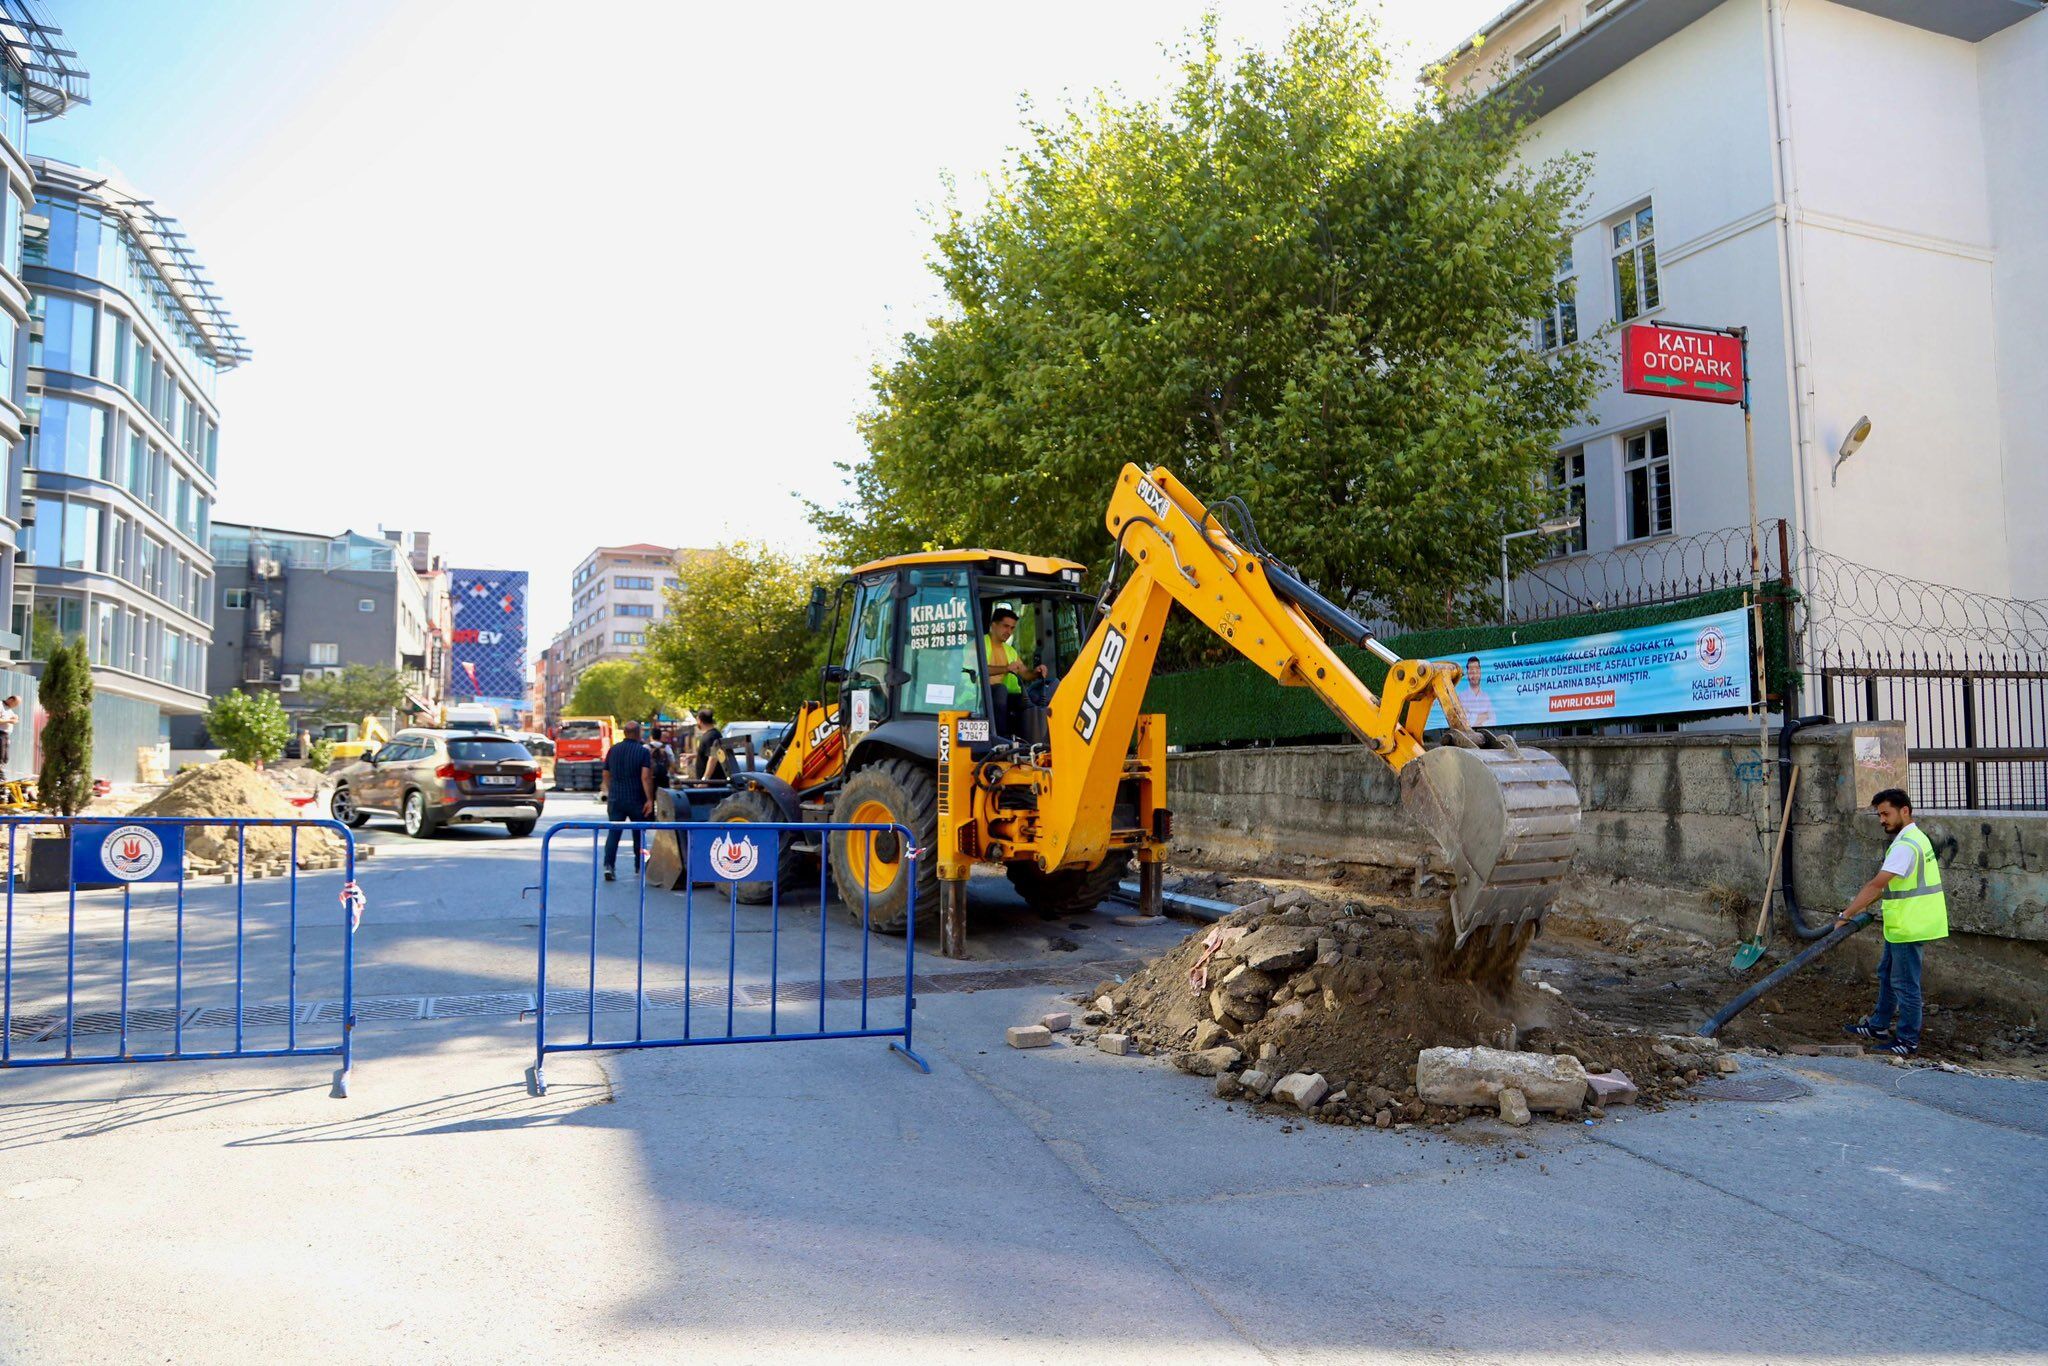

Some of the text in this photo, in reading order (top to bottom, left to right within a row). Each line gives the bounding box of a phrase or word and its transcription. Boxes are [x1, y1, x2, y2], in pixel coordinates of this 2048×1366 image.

[1659, 333, 1713, 356] KATLI
[1643, 351, 1733, 378] OTOPARK
[911, 620, 967, 636] 0532 245 19 37
[911, 633, 968, 650] 0534 278 58 58
[1521, 668, 1550, 679] TRAFİK
[1551, 662, 1603, 677] DÜZENLEME,
[1604, 658, 1639, 670] ASFALT
[1639, 655, 1650, 666] VE
[1652, 650, 1687, 663] PEYZAJ
[1081, 630, 1124, 740] JCB
[1516, 670, 1651, 696] ÇALIŞMALARINA BAŞLANMIŞTIR.
[1551, 694, 1613, 709] HAYIRLI OLSUN
[1692, 688, 1740, 701] KAĞITHANE
[959, 722, 968, 731] 34
[979, 722, 988, 731] 23
[966, 732, 983, 740] 7947
[940, 725, 949, 761] 3CX
